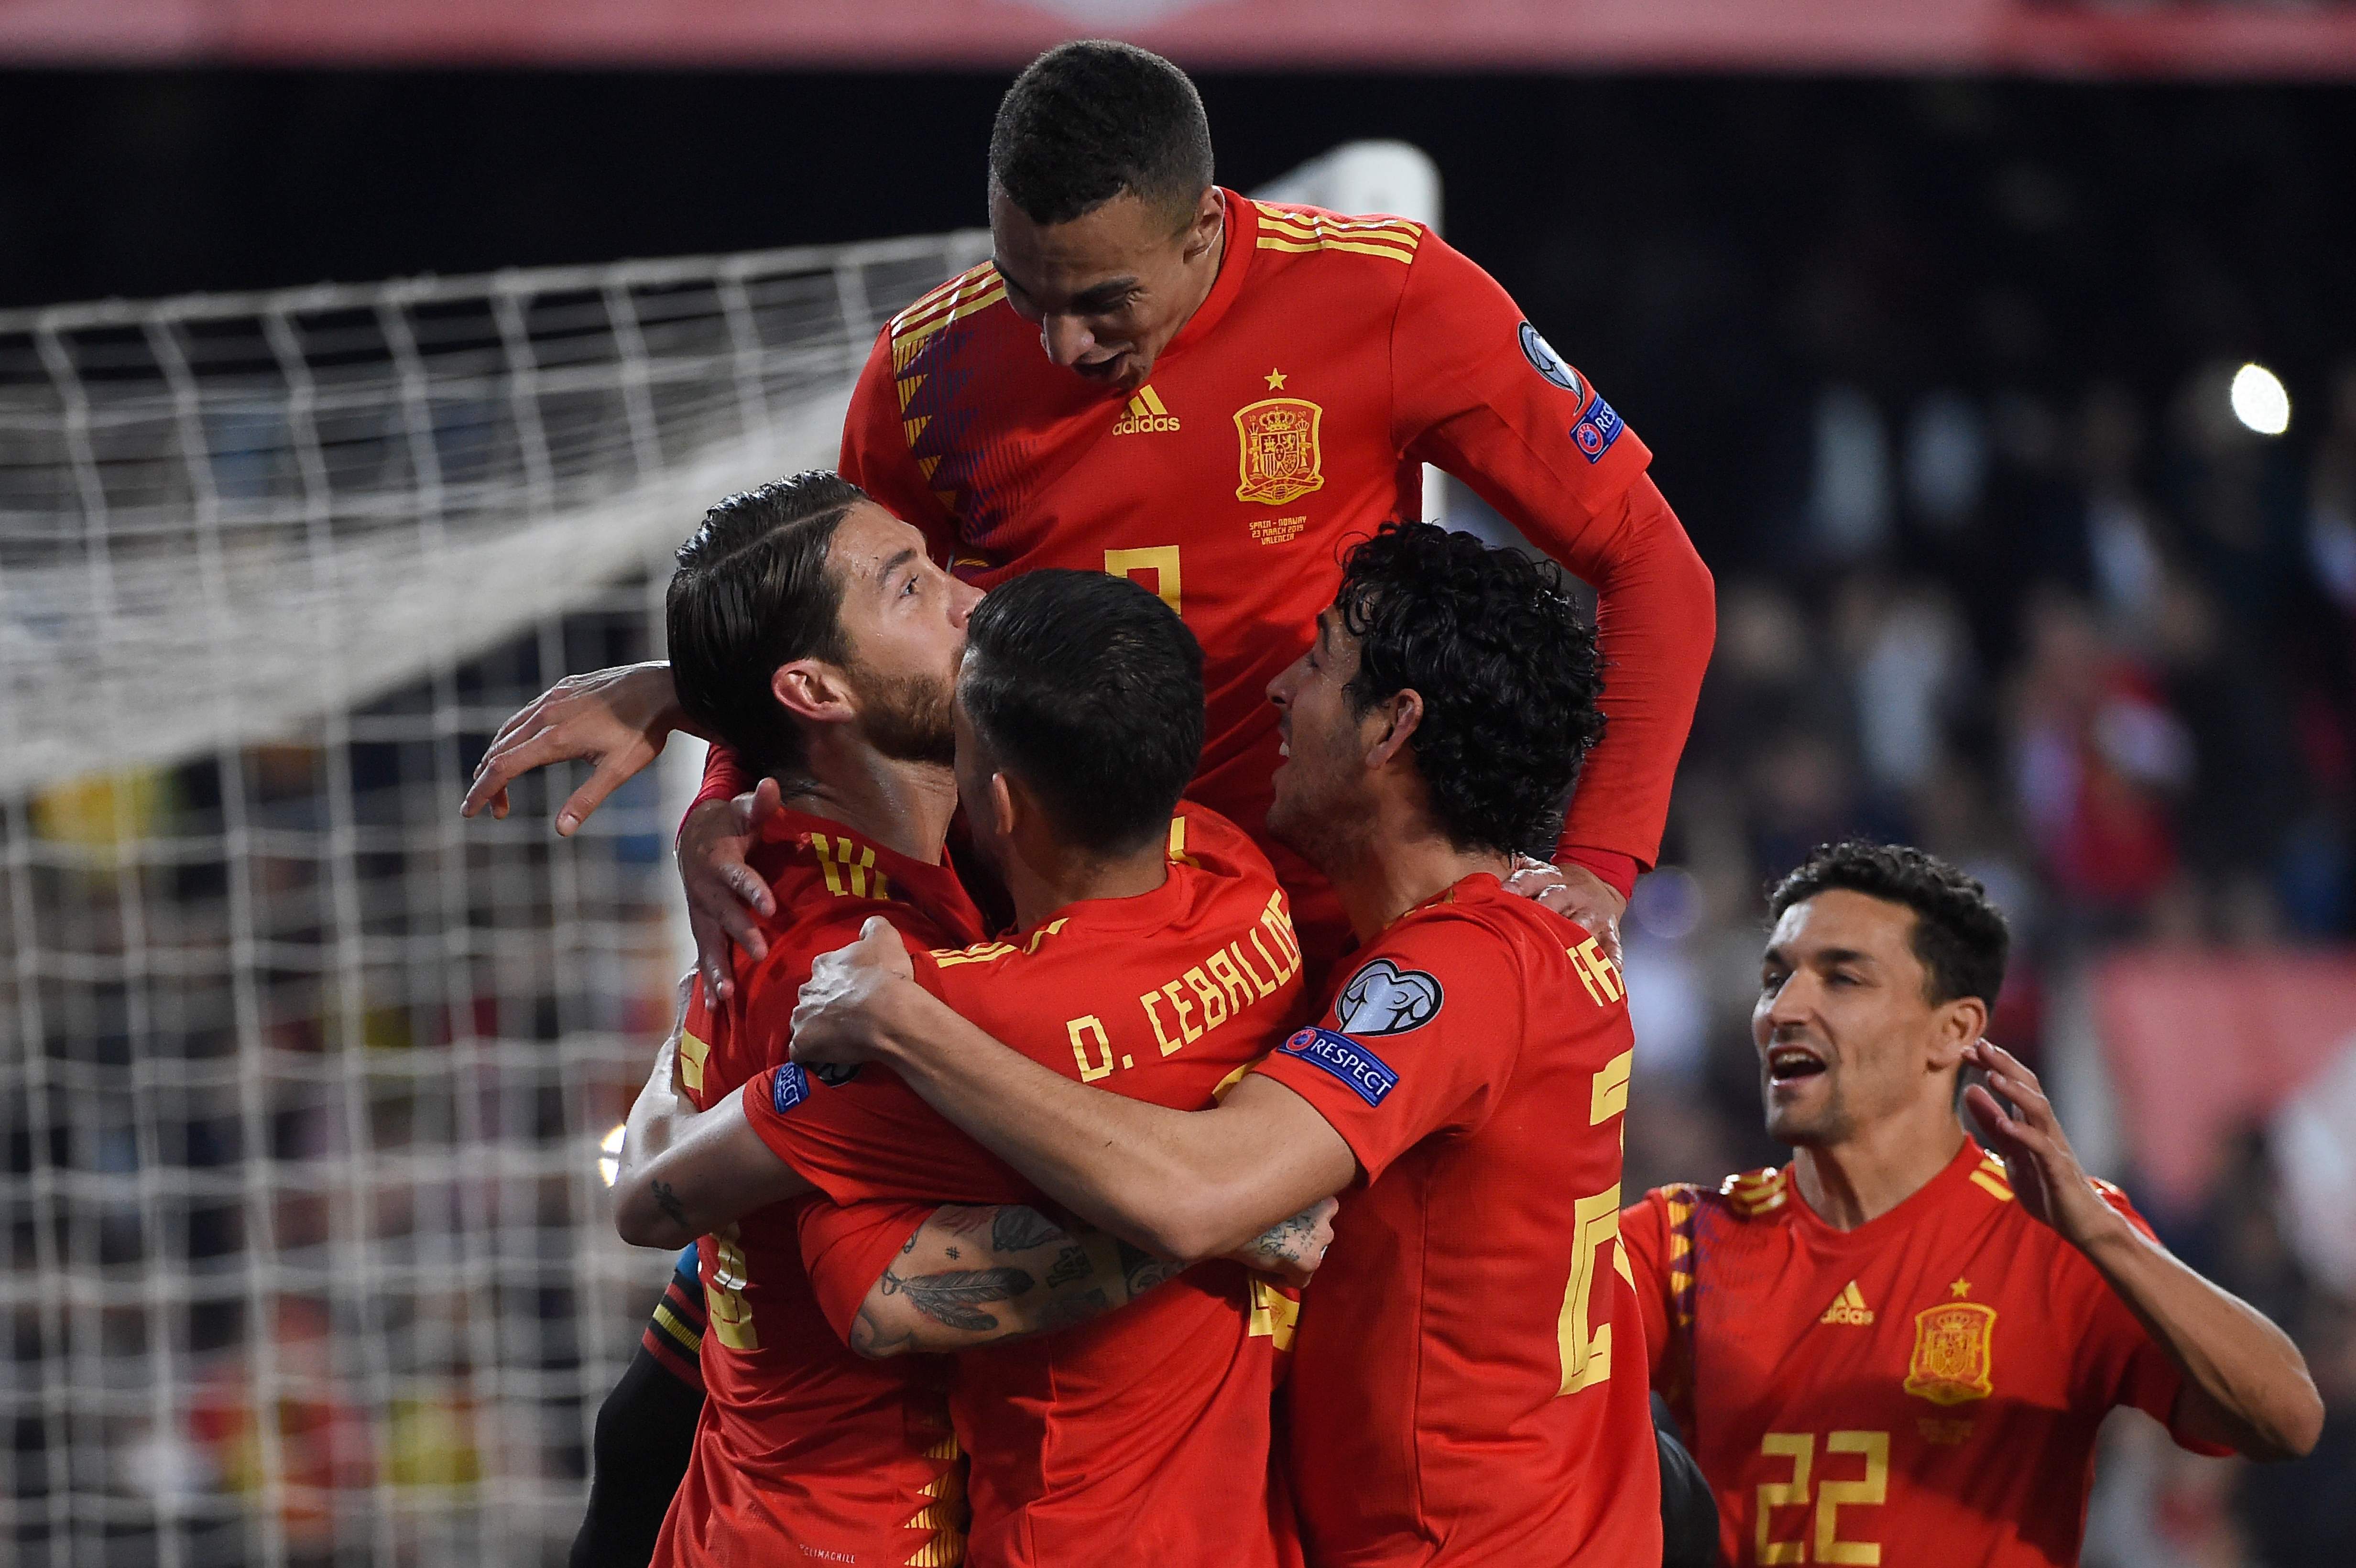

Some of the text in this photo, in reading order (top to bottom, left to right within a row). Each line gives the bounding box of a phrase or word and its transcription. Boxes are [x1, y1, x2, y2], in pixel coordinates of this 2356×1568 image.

[1113, 415, 1180, 435] adidas
[1249, 520, 1272, 531] SPAIN
[1278, 516, 1307, 527] NORWAY
[1252, 524, 1304, 538] 23 MARCH 2019
[1261, 533, 1295, 545] VALENCIA
[1066, 1014, 1134, 1083] D.
[1310, 1038, 1392, 1096] RESPECT
[1755, 1430, 1890, 1568] 22
